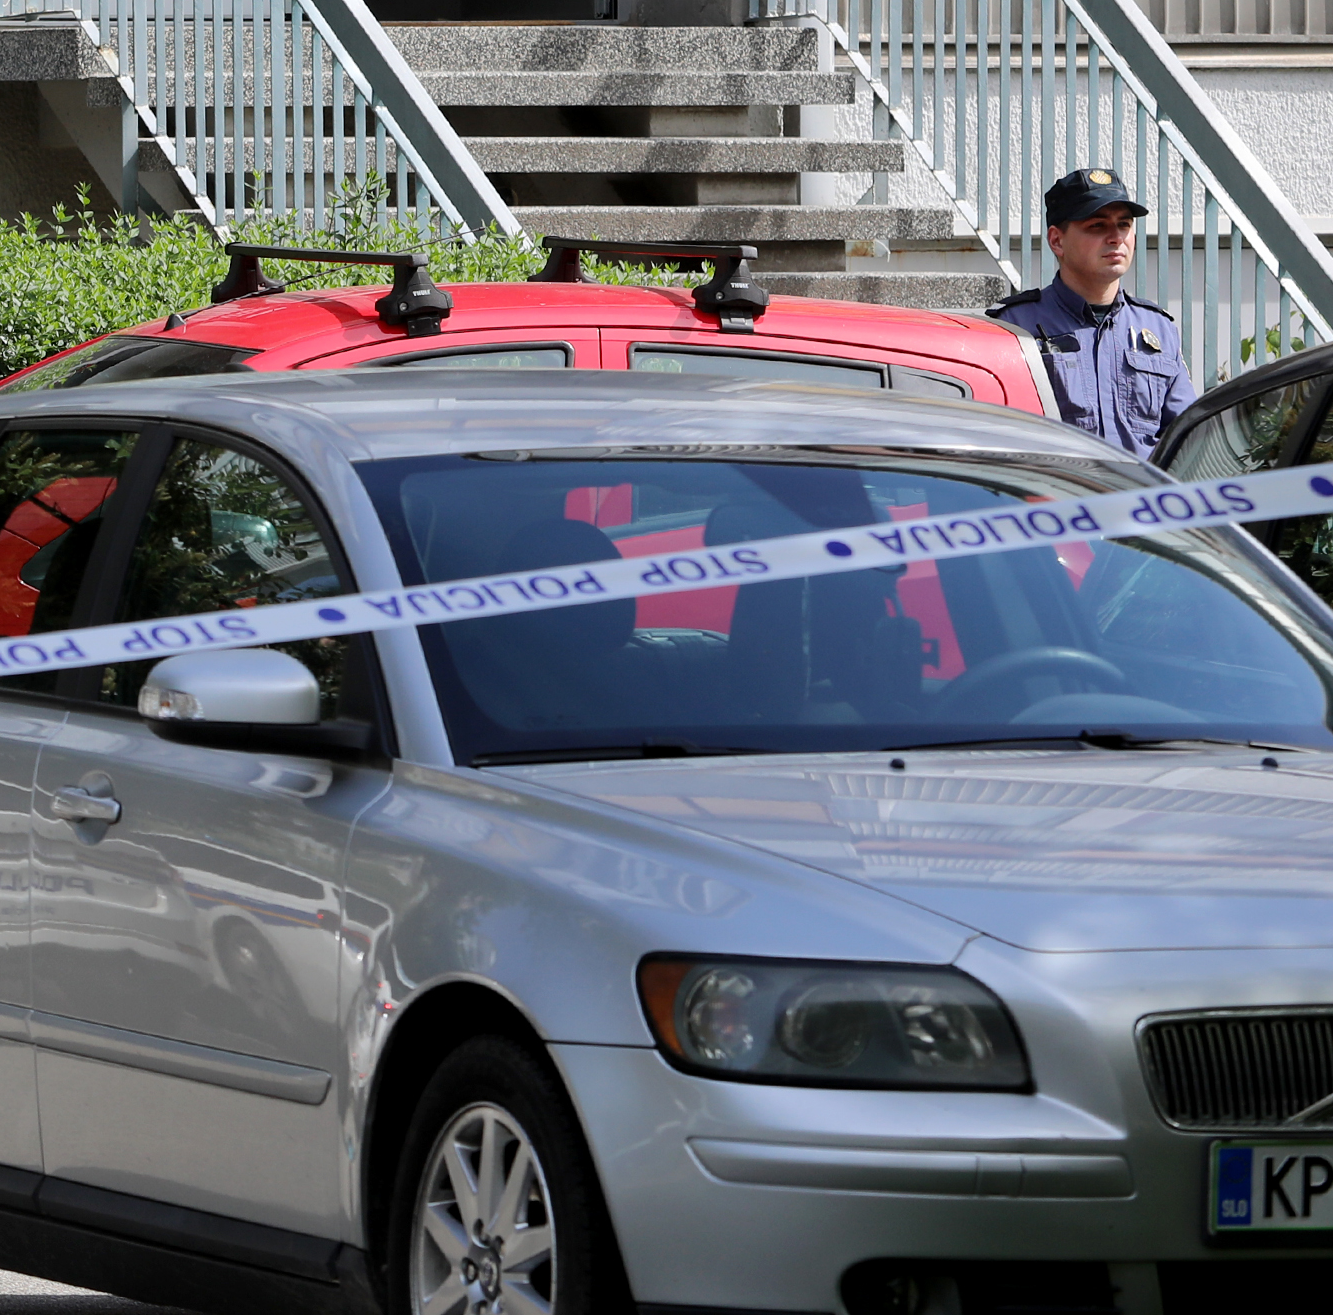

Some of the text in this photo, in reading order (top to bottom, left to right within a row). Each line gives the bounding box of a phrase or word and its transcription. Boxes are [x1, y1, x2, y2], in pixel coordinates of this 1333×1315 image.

[1130, 483, 1254, 524] STOP
[869, 504, 1102, 555] POLICIJA
[640, 548, 770, 586] STOP
[365, 570, 607, 619] POLICIJA
[122, 615, 257, 652] STOP
[1263, 1156, 1333, 1218] KP
[1222, 1199, 1248, 1218] SLO
